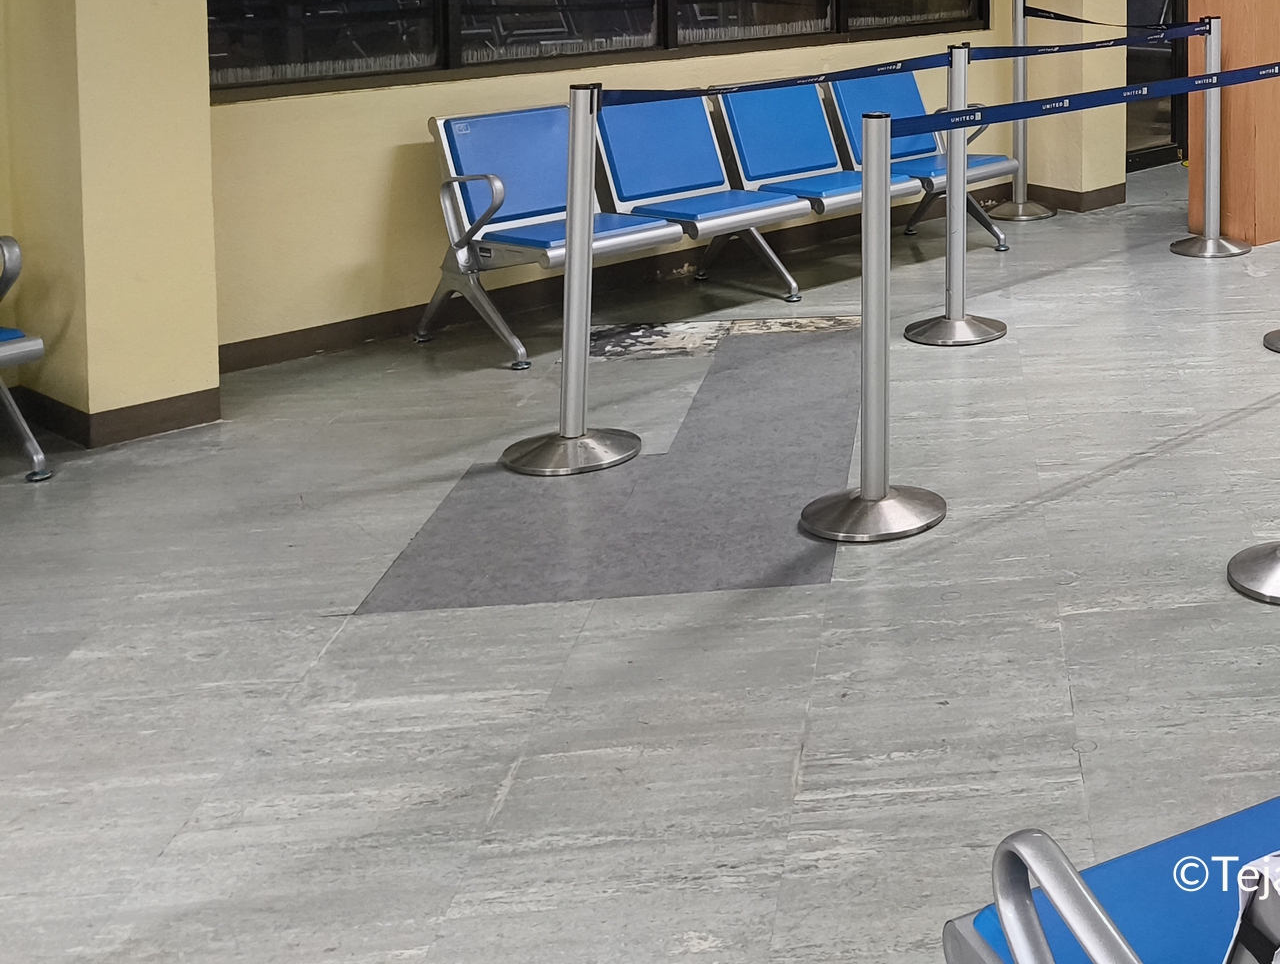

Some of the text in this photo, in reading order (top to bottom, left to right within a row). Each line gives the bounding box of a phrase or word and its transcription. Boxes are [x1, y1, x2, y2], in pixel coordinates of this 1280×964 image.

[1123, 89, 1142, 97] UNITED
[1042, 101, 1063, 110] UNITED
[951, 115, 975, 123] UNITED
